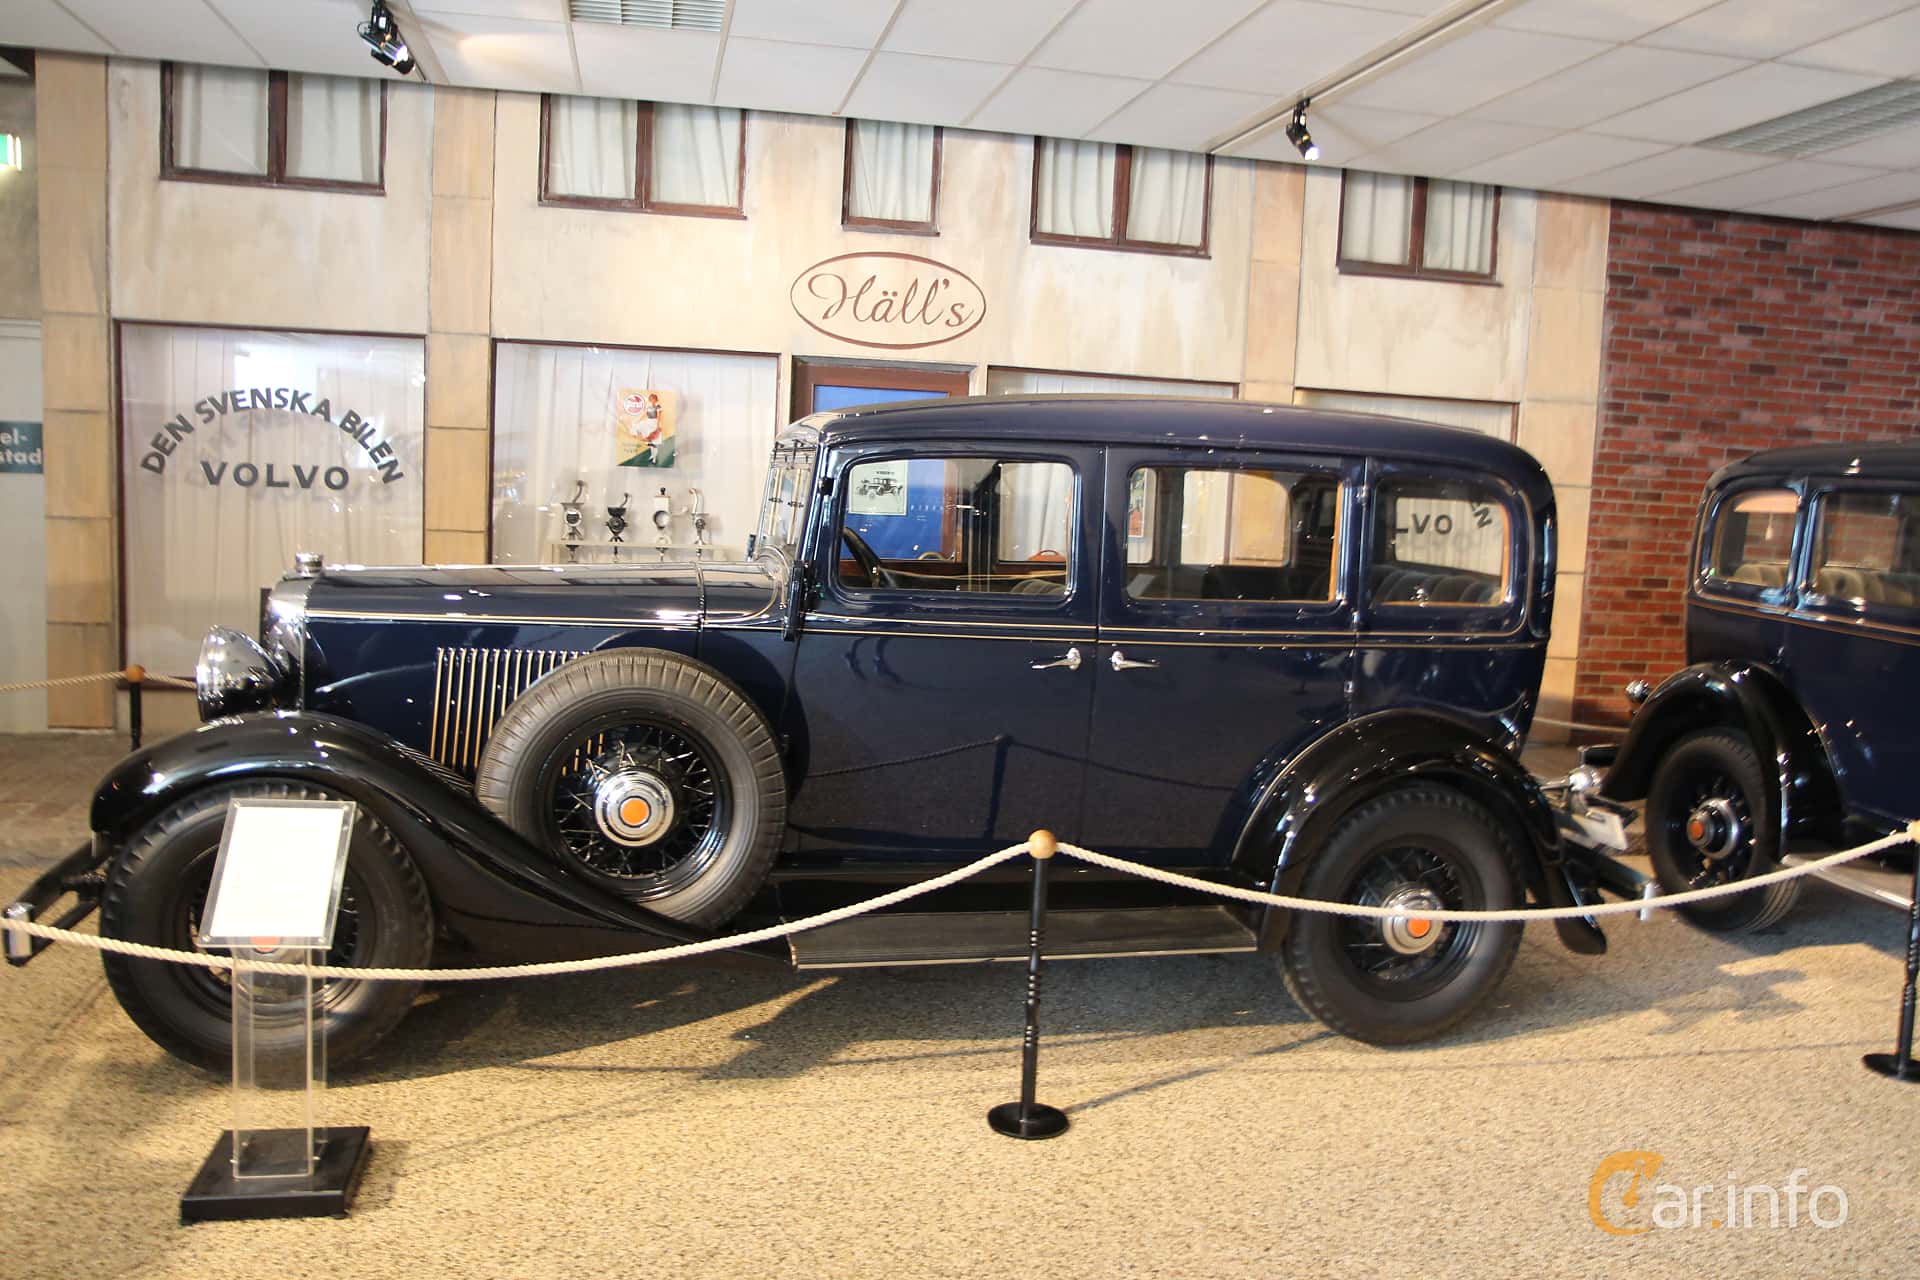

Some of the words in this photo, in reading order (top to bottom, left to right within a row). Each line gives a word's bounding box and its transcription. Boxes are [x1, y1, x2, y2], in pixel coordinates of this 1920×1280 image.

[808, 273, 974, 327] Häll's
[140, 413, 195, 475] DEN
[195, 387, 331, 424] SVENSKA
[339, 409, 404, 484] BILEN
[200, 460, 349, 490] VOLVO
